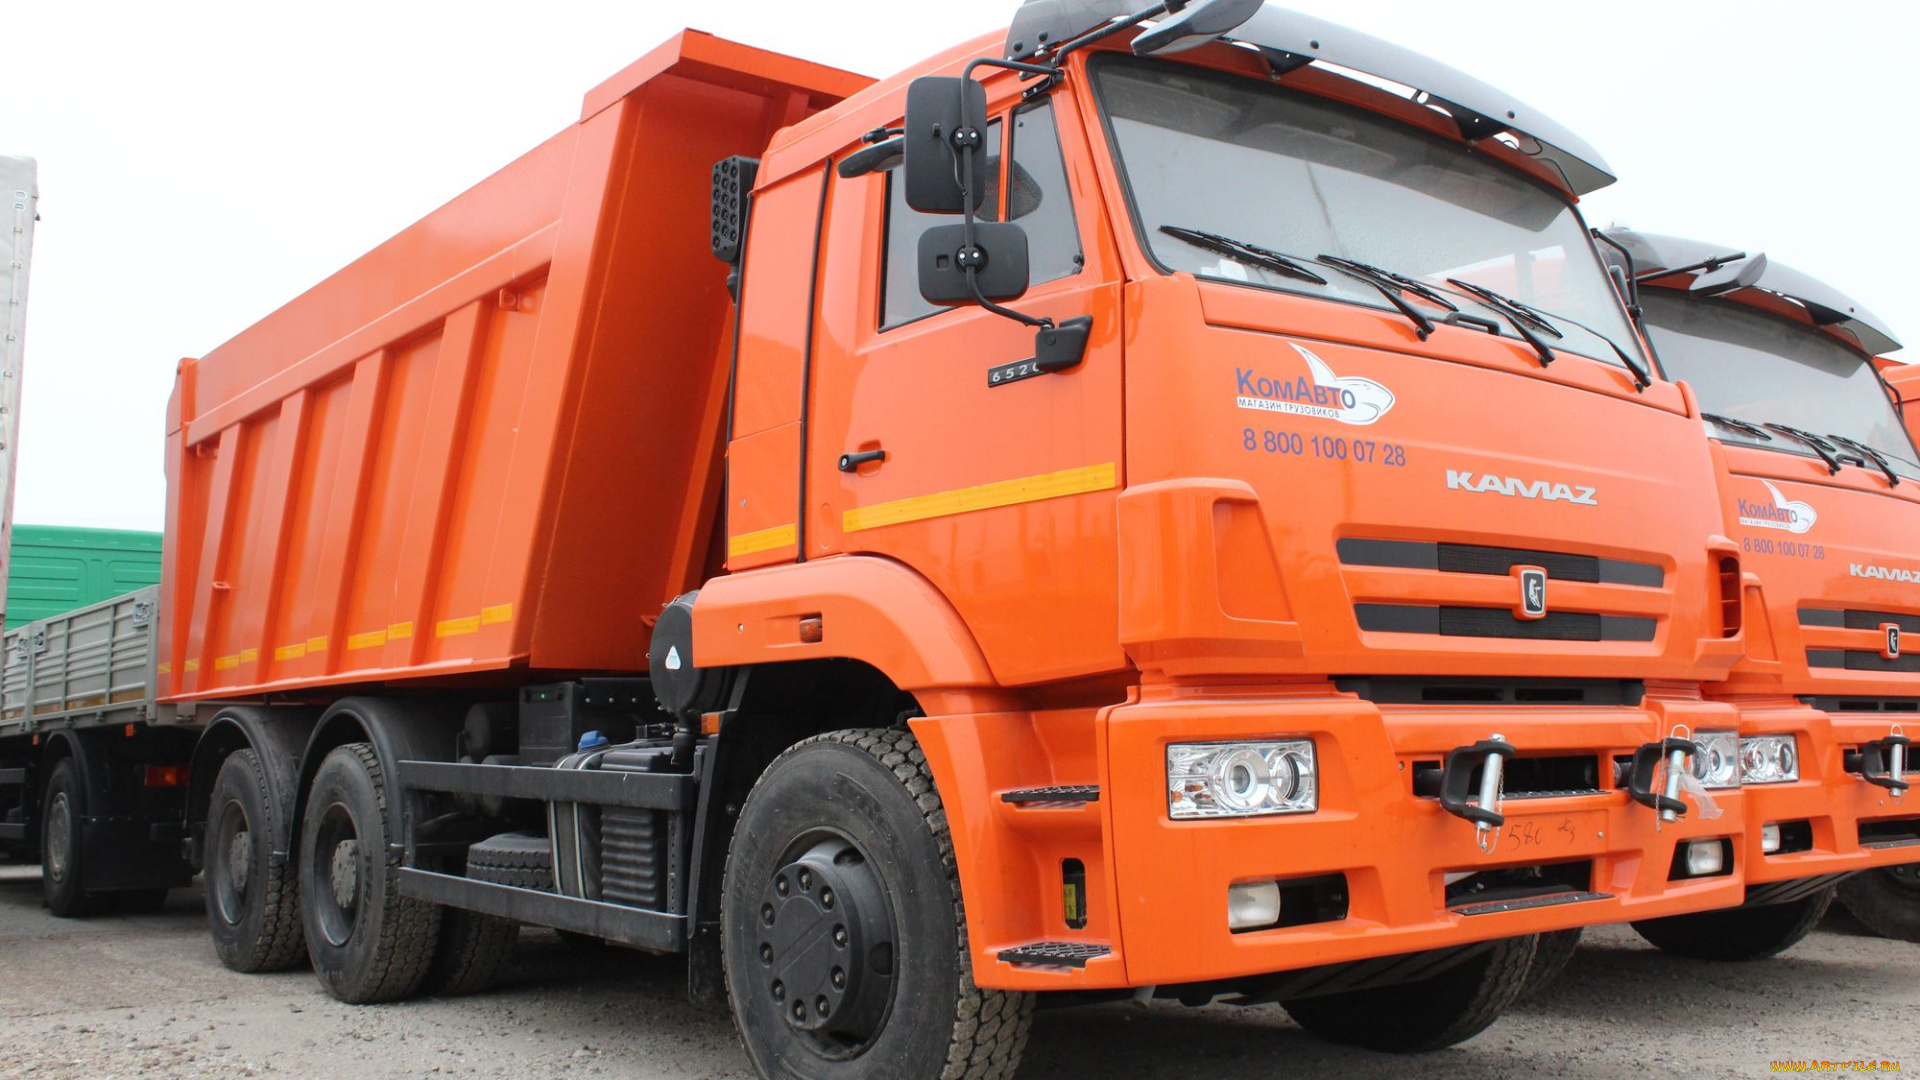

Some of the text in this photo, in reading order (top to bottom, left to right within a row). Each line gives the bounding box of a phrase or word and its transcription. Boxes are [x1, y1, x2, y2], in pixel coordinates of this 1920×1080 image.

[1238, 398, 1340, 418] МАГАЗИН ГРУЗОВИКОВ
[1243, 428, 1406, 467] 8 800 100 07 28
[1446, 469, 1598, 506] KAMAZ
[1744, 537, 1825, 560] 8 800 100 07 28
[1850, 563, 1920, 583] KAMAZ
